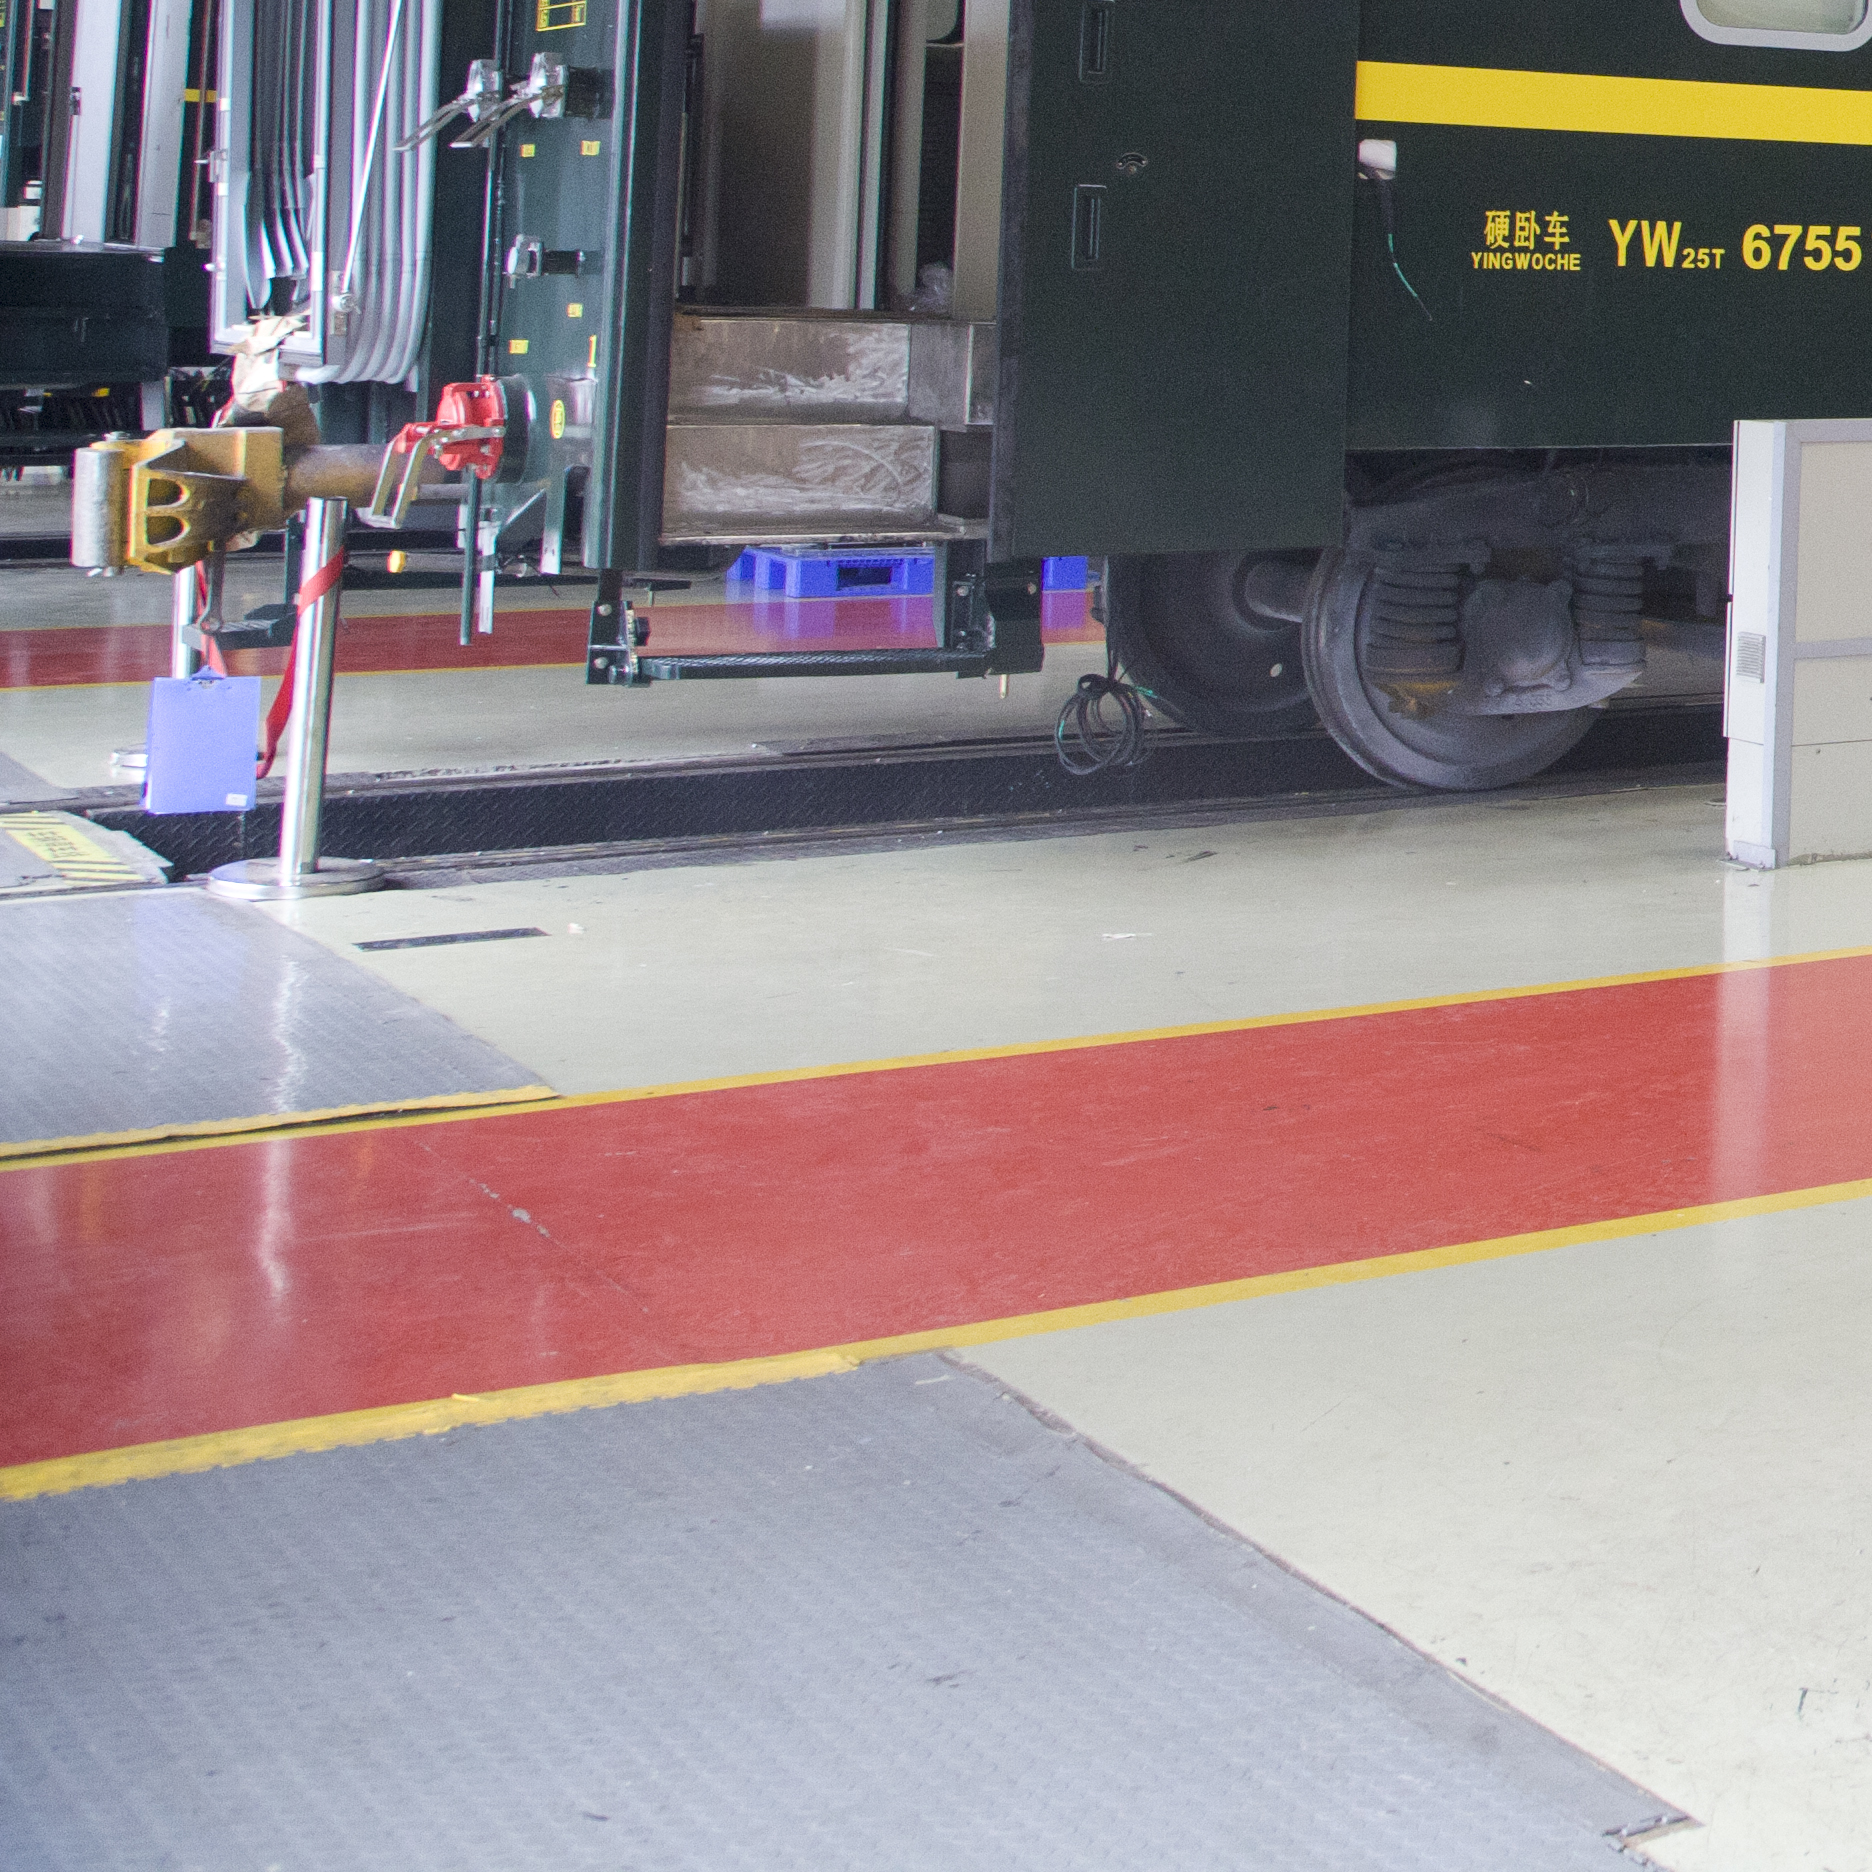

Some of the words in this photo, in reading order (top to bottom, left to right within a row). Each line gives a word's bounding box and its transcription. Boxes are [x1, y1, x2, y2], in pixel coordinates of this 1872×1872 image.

[1484, 210, 1570, 250] 硬卧车
[1471, 252, 1581, 271] YINGWOCHE
